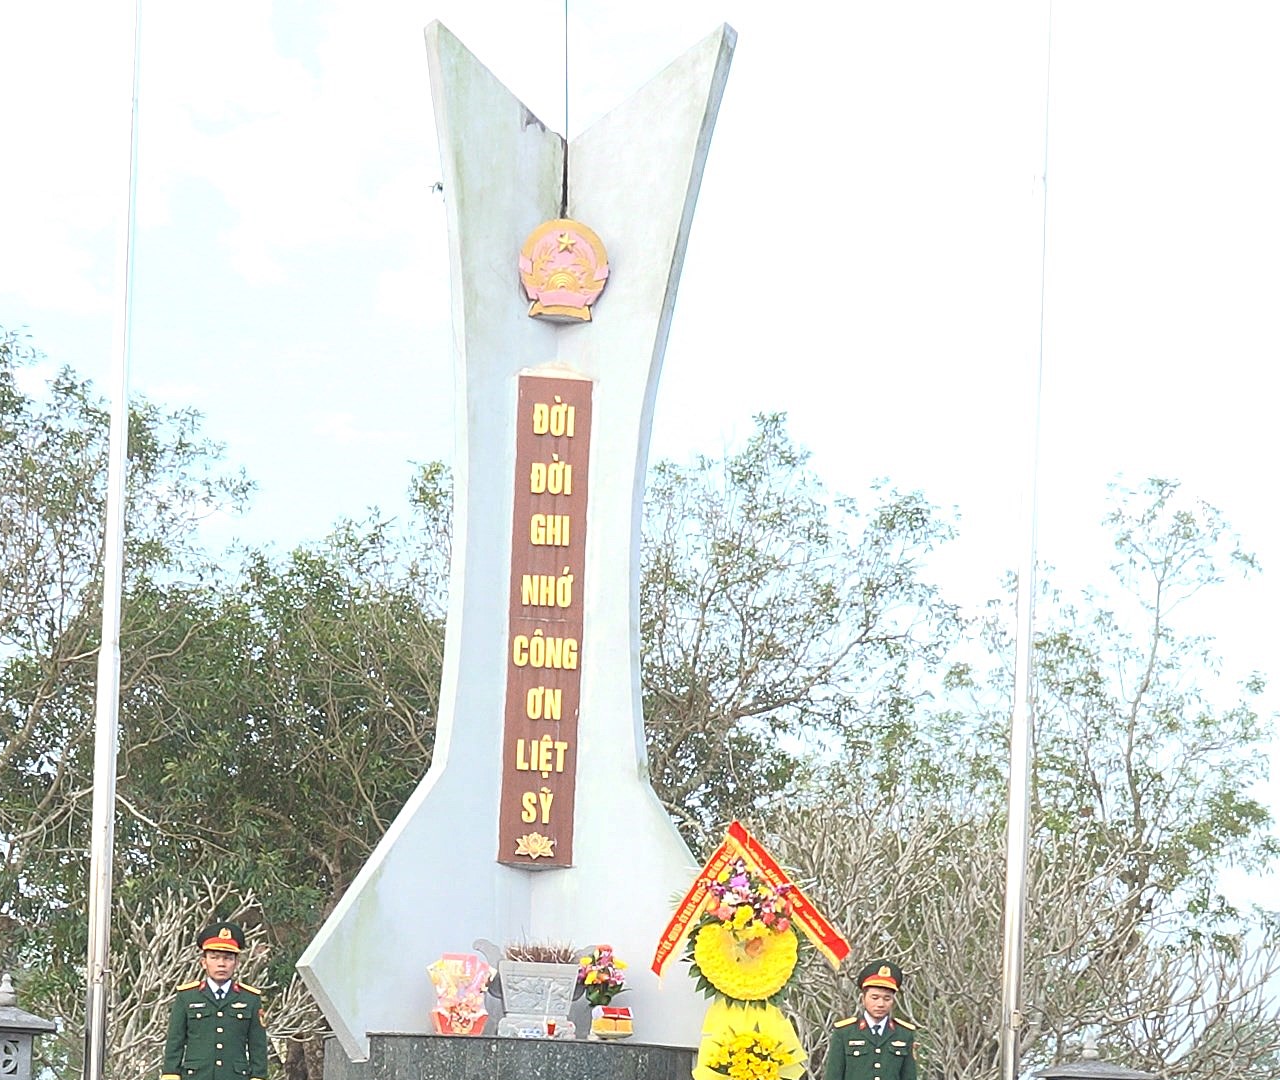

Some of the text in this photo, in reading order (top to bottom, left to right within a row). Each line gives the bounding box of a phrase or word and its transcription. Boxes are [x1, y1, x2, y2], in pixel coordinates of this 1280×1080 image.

[532, 395, 575, 438] ĐỜI
[530, 453, 573, 496] ĐỜI
[530, 513, 570, 547] GHI
[521, 566, 574, 608] NHỚ
[513, 628, 578, 670] CÔNG
[526, 686, 562, 721] ƠN
[516, 734, 568, 778] LIỆT
[521, 786, 554, 824] SỸ
